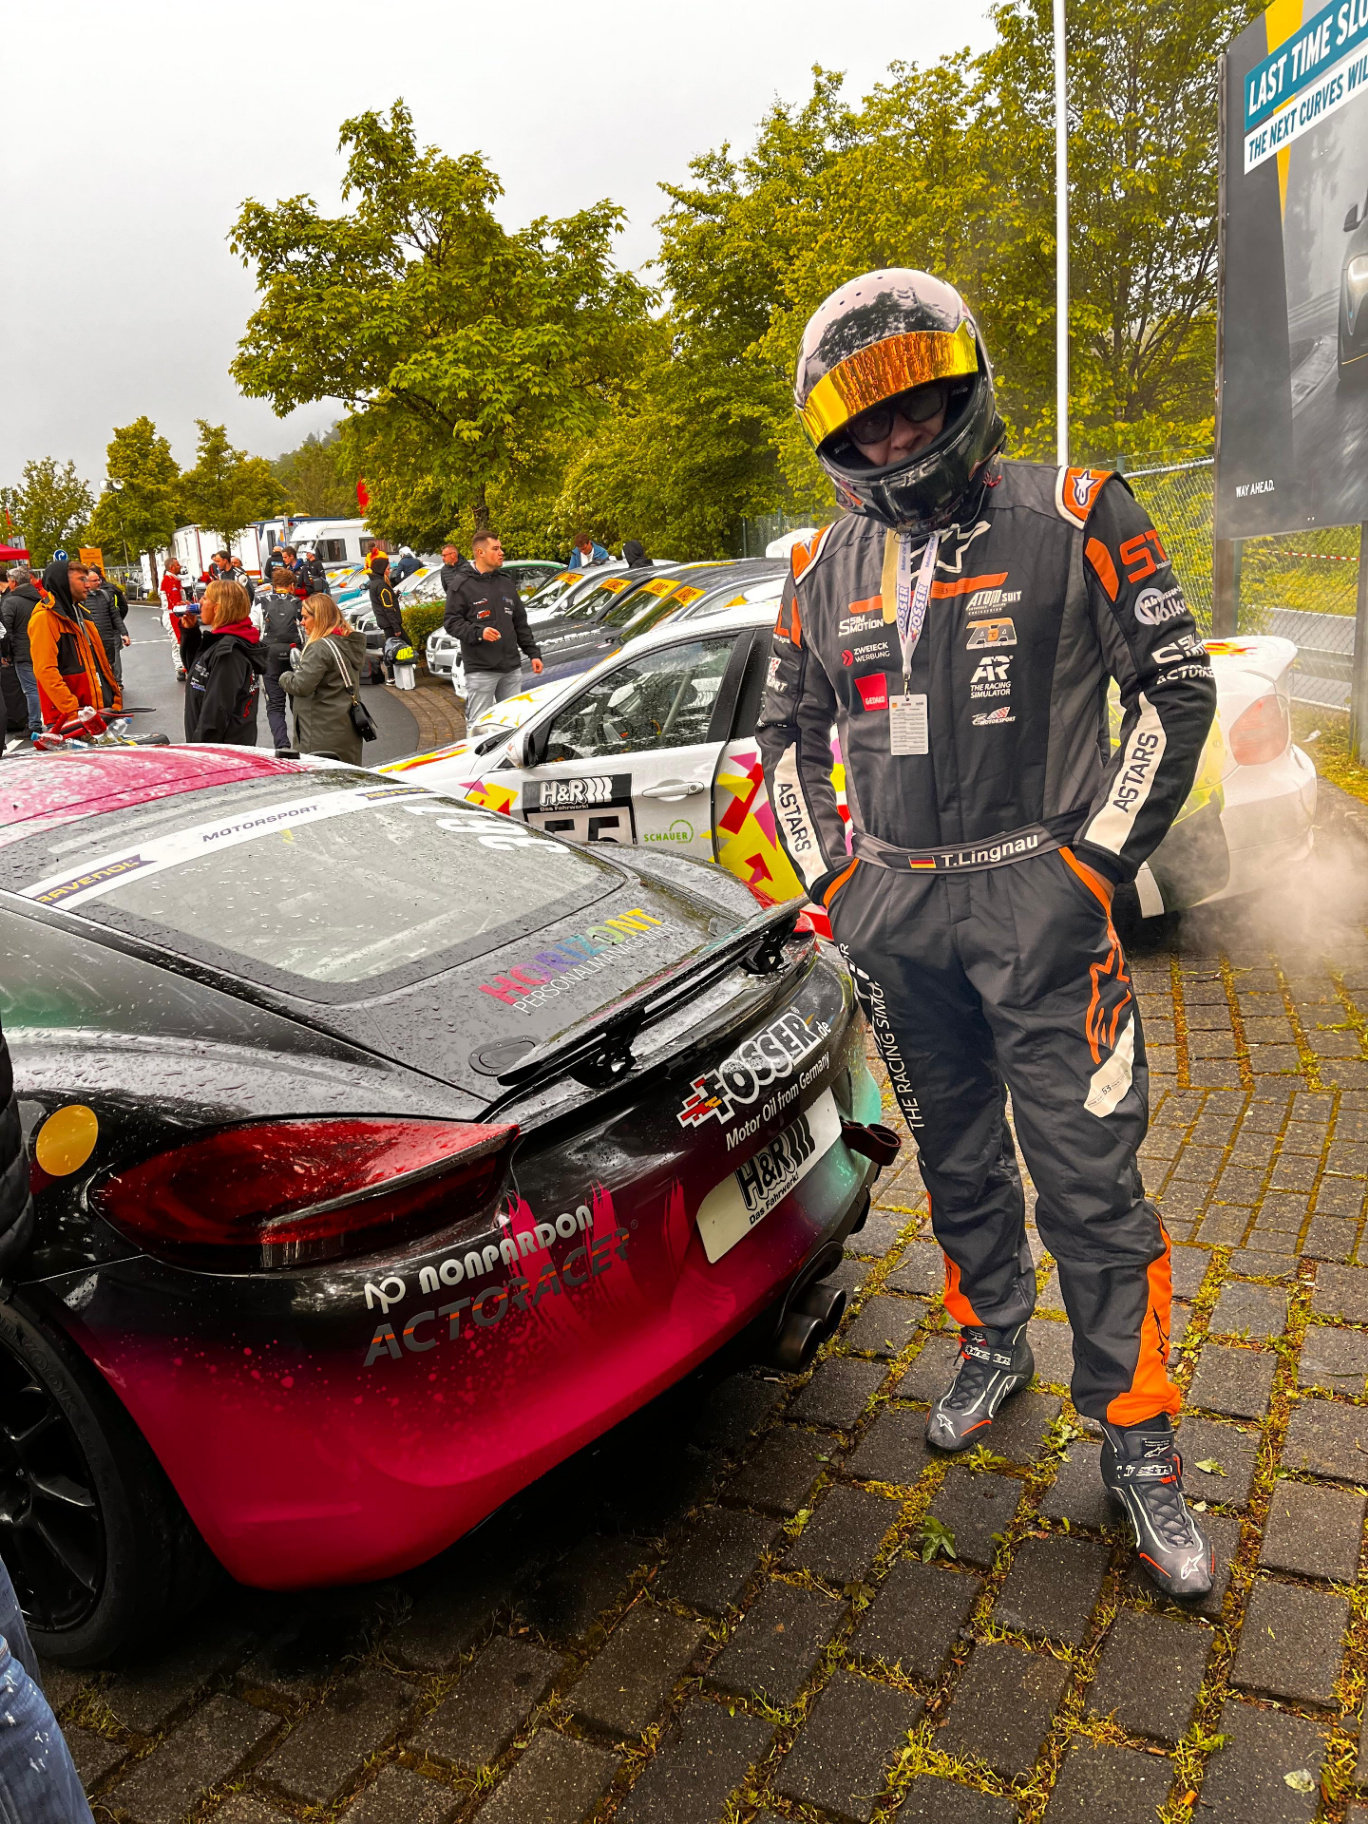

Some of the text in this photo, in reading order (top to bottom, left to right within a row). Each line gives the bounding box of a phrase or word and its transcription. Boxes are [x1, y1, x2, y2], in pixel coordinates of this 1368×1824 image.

[1249, 53, 1287, 116] LAST
[1291, 14, 1333, 82] TIME
[1249, 130, 1267, 162] THE
[1269, 107, 1297, 148] NEXT
[1300, 74, 1343, 126] CURVES
[1236, 480, 1275, 498] WAY AHEAD.
[1002, 591, 1022, 602] SUIT
[854, 642, 889, 656] ZWEIECK
[855, 651, 890, 663] WERBUNG
[970, 681, 1011, 692] THE RACING
[970, 689, 1010, 699] SIMULATOR
[1113, 732, 1159, 814] ASTARS
[202, 805, 319, 843] MOTORSPORT
[644, 832, 688, 842] SCHAUER
[778, 783, 812, 853] ASTARS
[941, 835, 1038, 868] T.Lingnau
[478, 907, 663, 1006] HORIZONT
[512, 921, 681, 1014] PERSONALMANAGEMENT
[880, 1032, 914, 1094] RACING
[726, 1051, 830, 1151] Motor Oil from Germany
[901, 1097, 925, 1131] THE
[749, 1171, 799, 1226] Das Fahrwerk!
[419, 1205, 594, 1294] NONPARDON
